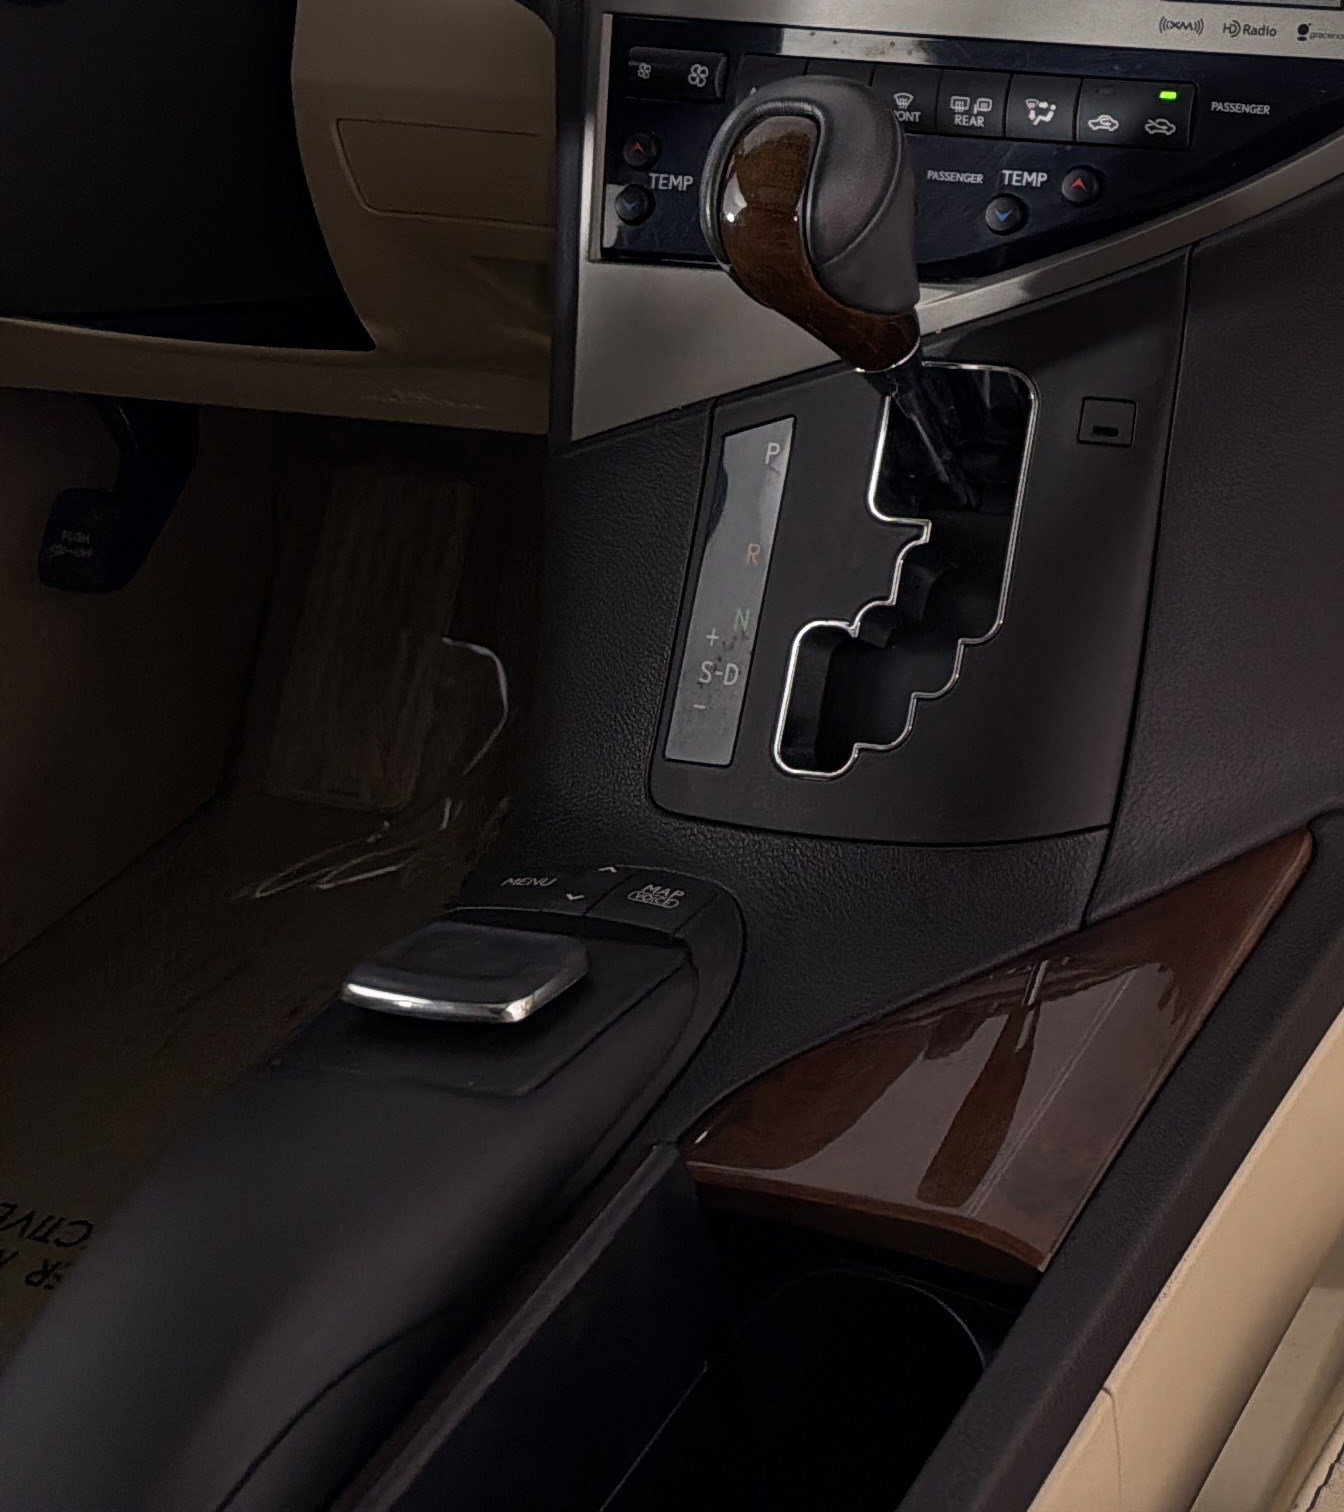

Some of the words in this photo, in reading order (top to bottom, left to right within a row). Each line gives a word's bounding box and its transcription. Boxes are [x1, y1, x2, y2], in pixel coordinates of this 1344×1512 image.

[1242, 24, 1278, 38] Radio
[893, 109, 921, 123] ONT
[1210, 101, 1271, 116] PASSENGER
[953, 114, 985, 128] REAR
[649, 172, 694, 192] TEMP
[926, 170, 984, 185] PASSENGER
[1001, 169, 1048, 188] TEMP
[765, 442, 781, 465] P
[746, 544, 761, 564] R
[733, 609, 751, 630] N
[500, 877, 558, 888] MENU
[632, 891, 679, 908] VOICE
[641, 884, 686, 899] MAP
